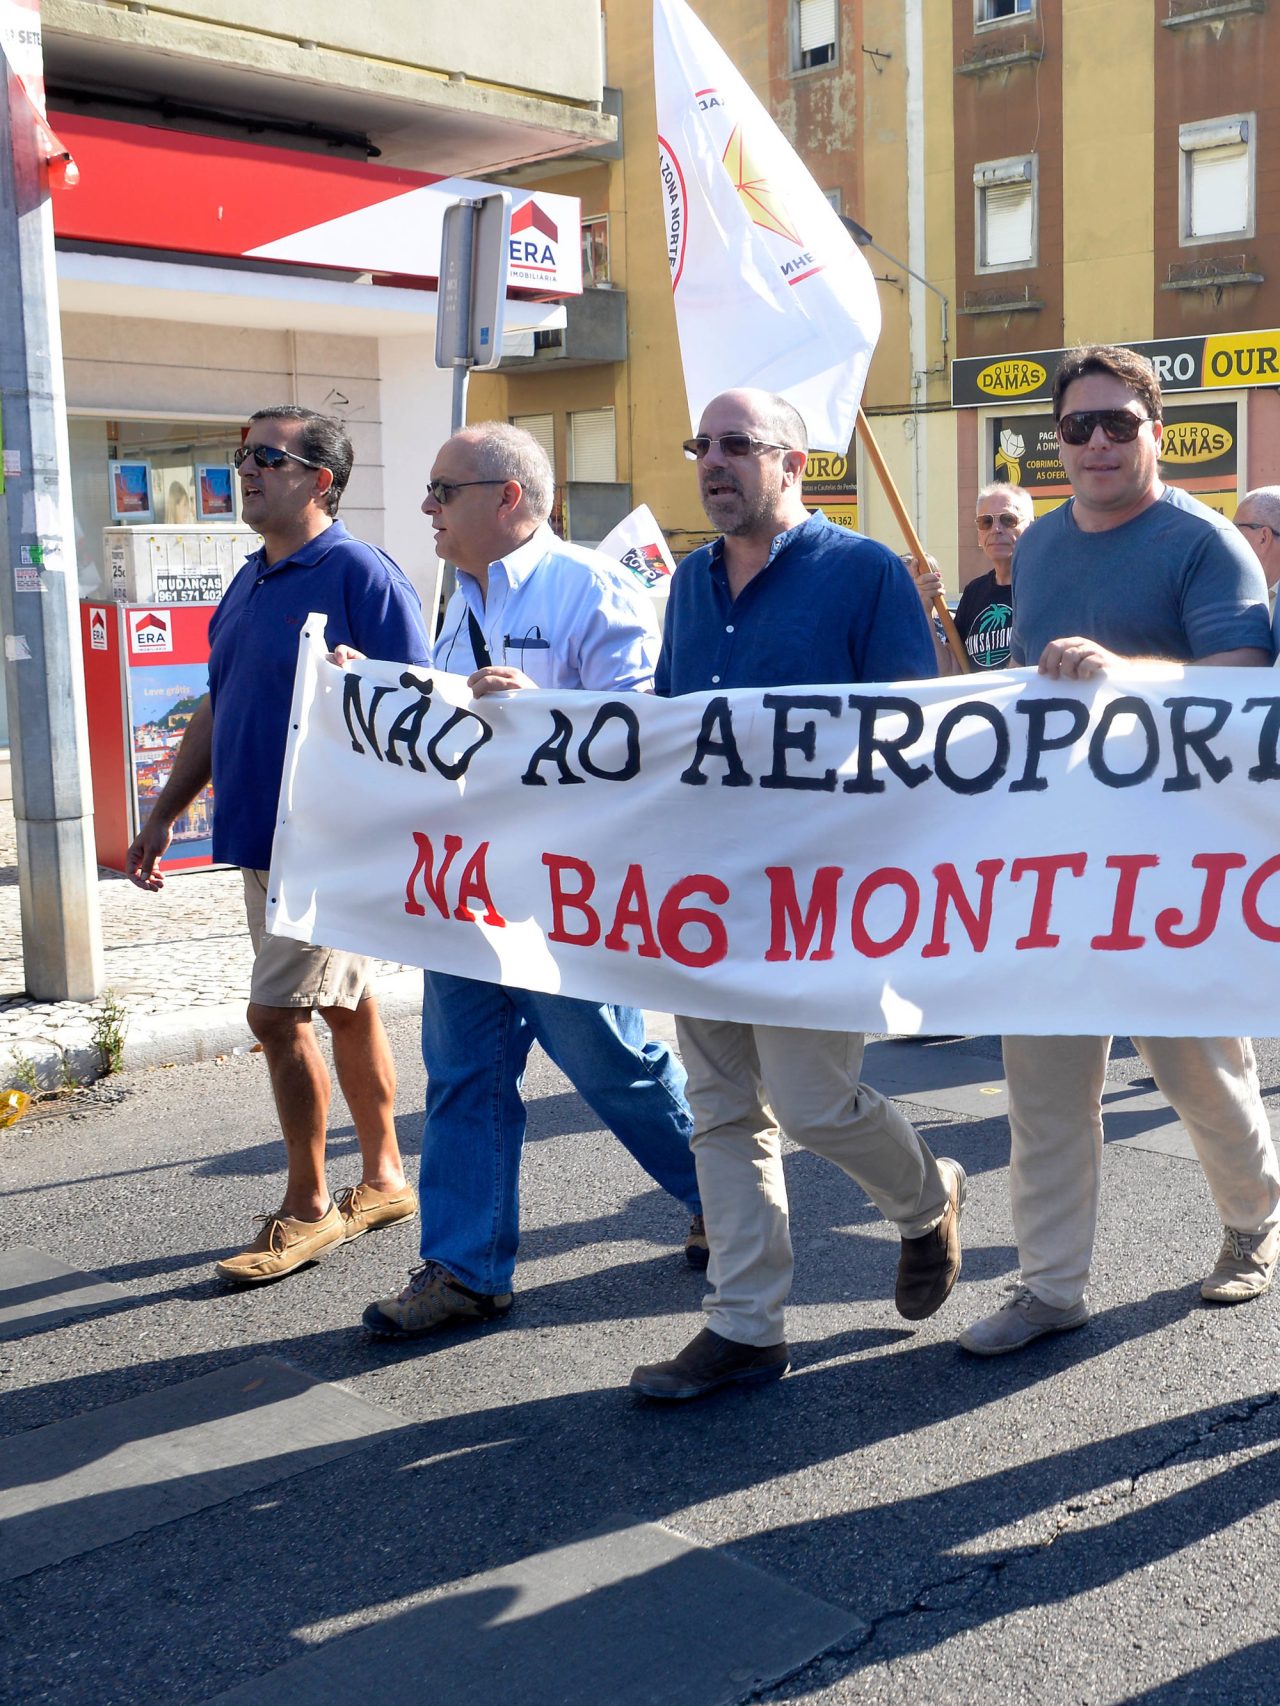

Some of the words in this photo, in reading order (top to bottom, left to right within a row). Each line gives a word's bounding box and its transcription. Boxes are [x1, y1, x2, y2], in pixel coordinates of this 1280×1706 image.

[662, 162, 679, 206] ZONA
[509, 240, 556, 266] ERA
[510, 271, 558, 282] IMOBILIÁRIA
[994, 363, 1029, 376] OURO
[983, 369, 1040, 390] DAMAS
[1166, 426, 1210, 440] OURO
[1036, 472, 1046, 480] AS
[158, 577, 222, 593] MUDANÇAS
[158, 590, 178, 602] 961
[180, 590, 199, 602] 571
[92, 629, 105, 641] ERA
[137, 632, 166, 644] ERA
[341, 671, 494, 782] NÃO
[521, 701, 642, 787] AO
[404, 831, 507, 929] NA
[541, 851, 731, 969] BA6
